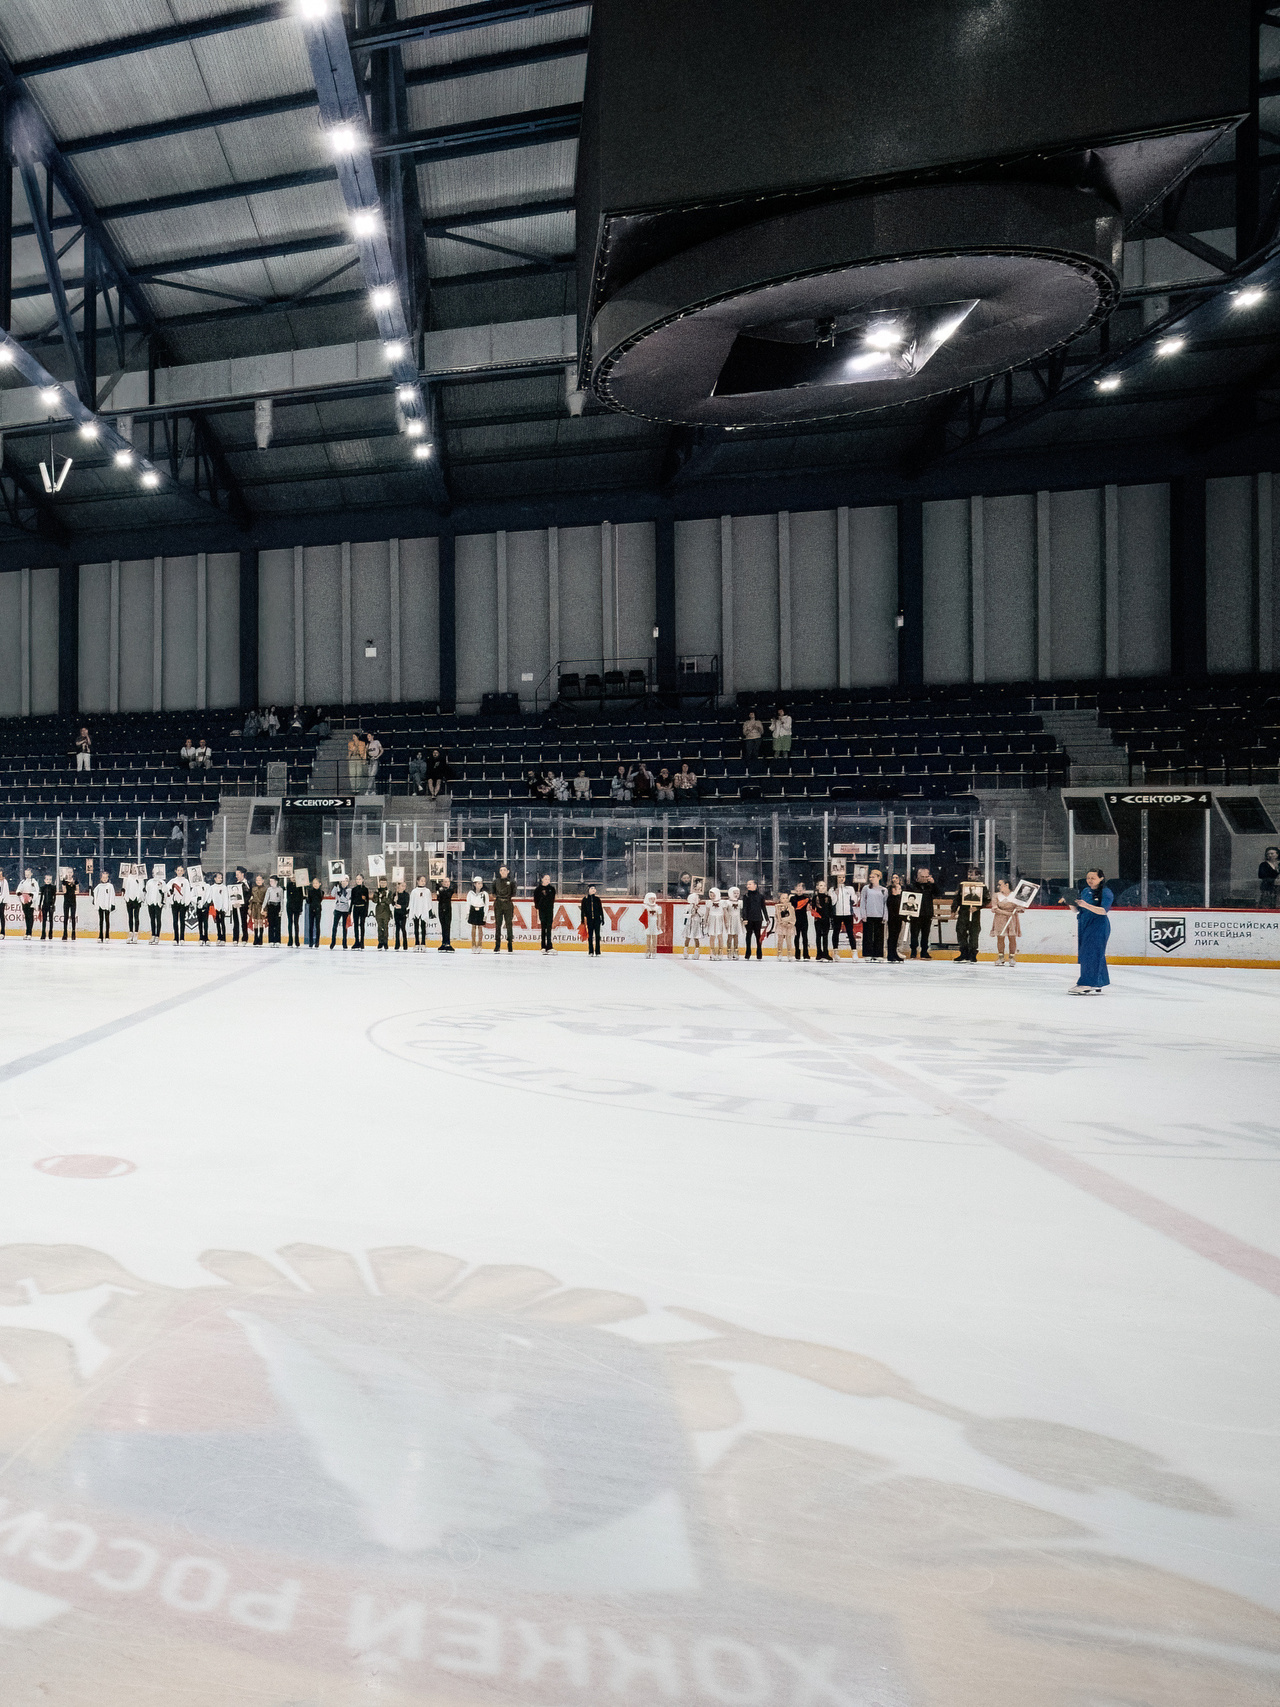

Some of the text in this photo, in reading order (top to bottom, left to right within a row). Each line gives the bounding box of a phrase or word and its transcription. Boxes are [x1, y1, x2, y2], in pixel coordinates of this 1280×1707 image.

[302, 799, 335, 807] СЕКТОР
[1110, 795, 1207, 804] 3 СЕКТОР 4
[483, 904, 628, 932] GALAY
[1194, 921, 1279, 930] ВСЕРОССИЙСКАЯ
[1150, 925, 1185, 941] ВХЛ
[1194, 930, 1252, 938] ХОККЕЙНАЯ
[345, 1596, 847, 1706] ХОККЕЙ
